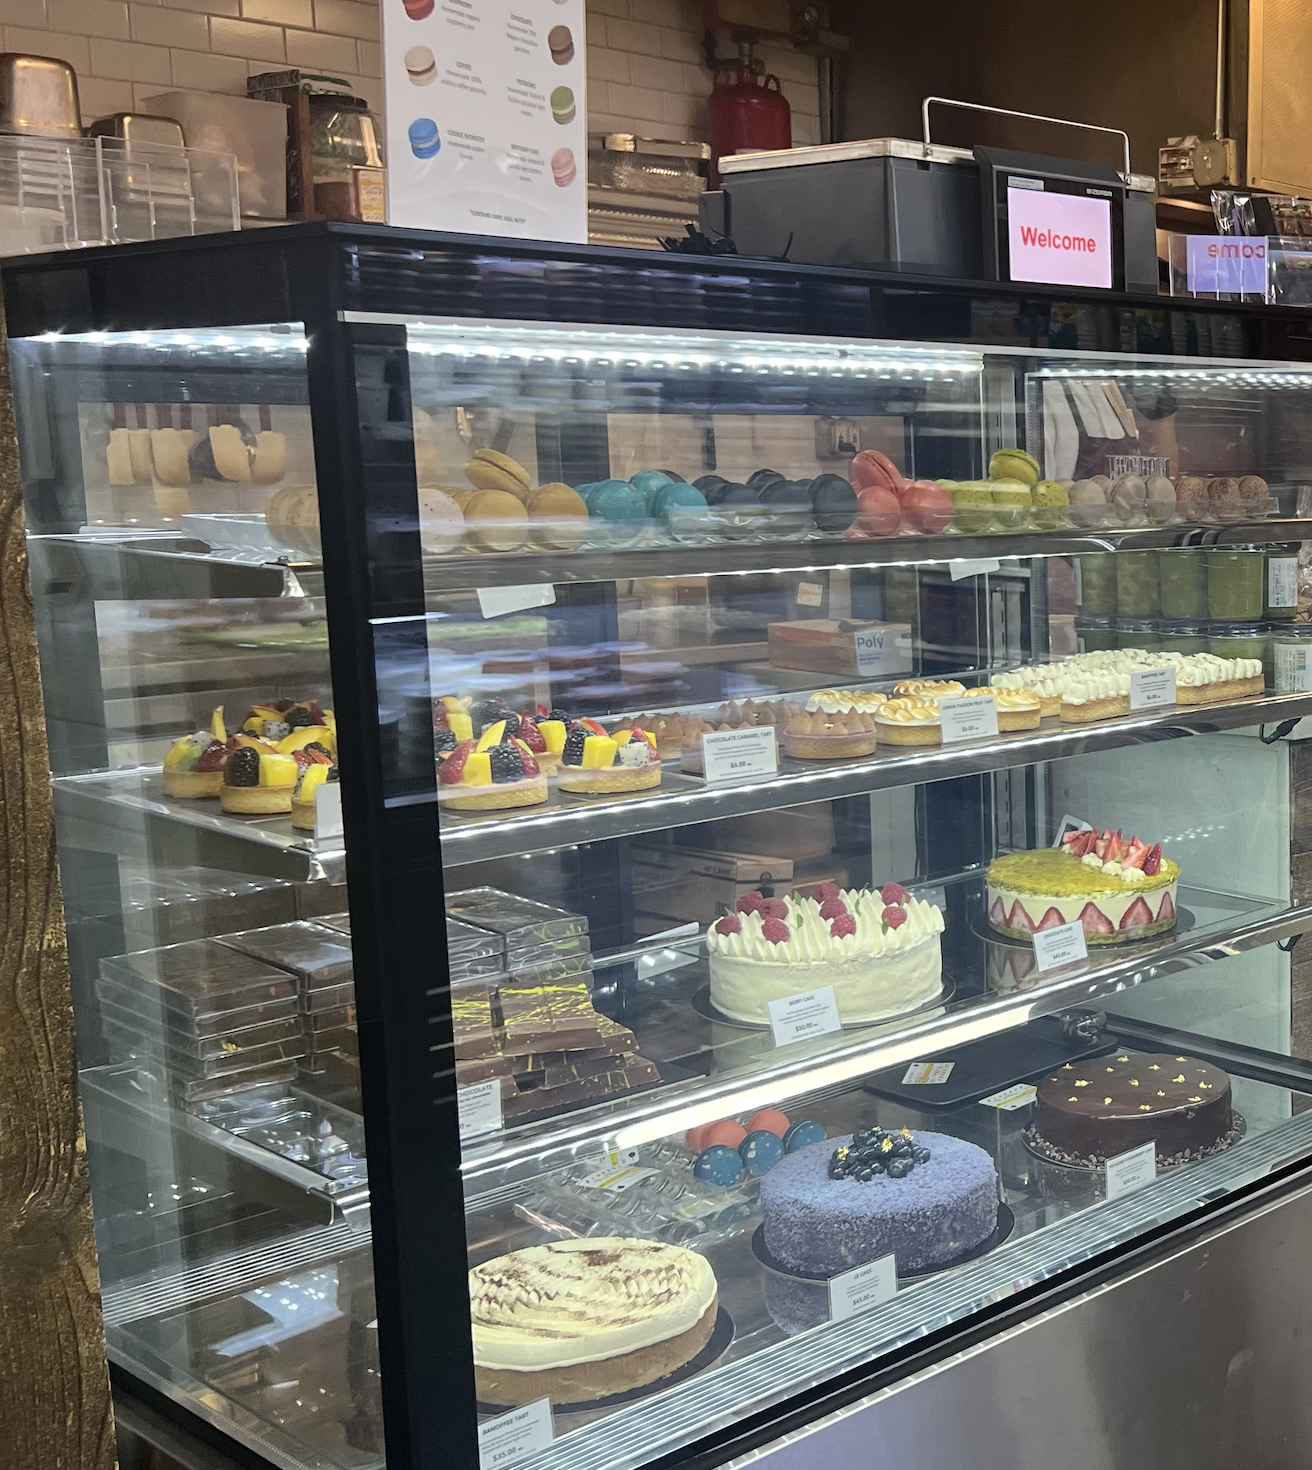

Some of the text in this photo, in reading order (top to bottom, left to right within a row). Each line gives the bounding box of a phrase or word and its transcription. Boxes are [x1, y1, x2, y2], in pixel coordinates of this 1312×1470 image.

[1020, 226, 1096, 253] Welcome
[857, 636, 883, 650] Poly
[707, 736, 736, 744] CHOCOLATE
[1044, 929, 1063, 939] CHOCOLATE
[795, 1022, 813, 1032] $50.00
[852, 1294, 870, 1305] $45.00
[482, 1412, 529, 1435] BANOFFEE TART
[493, 1447, 516, 1462] $35.00
